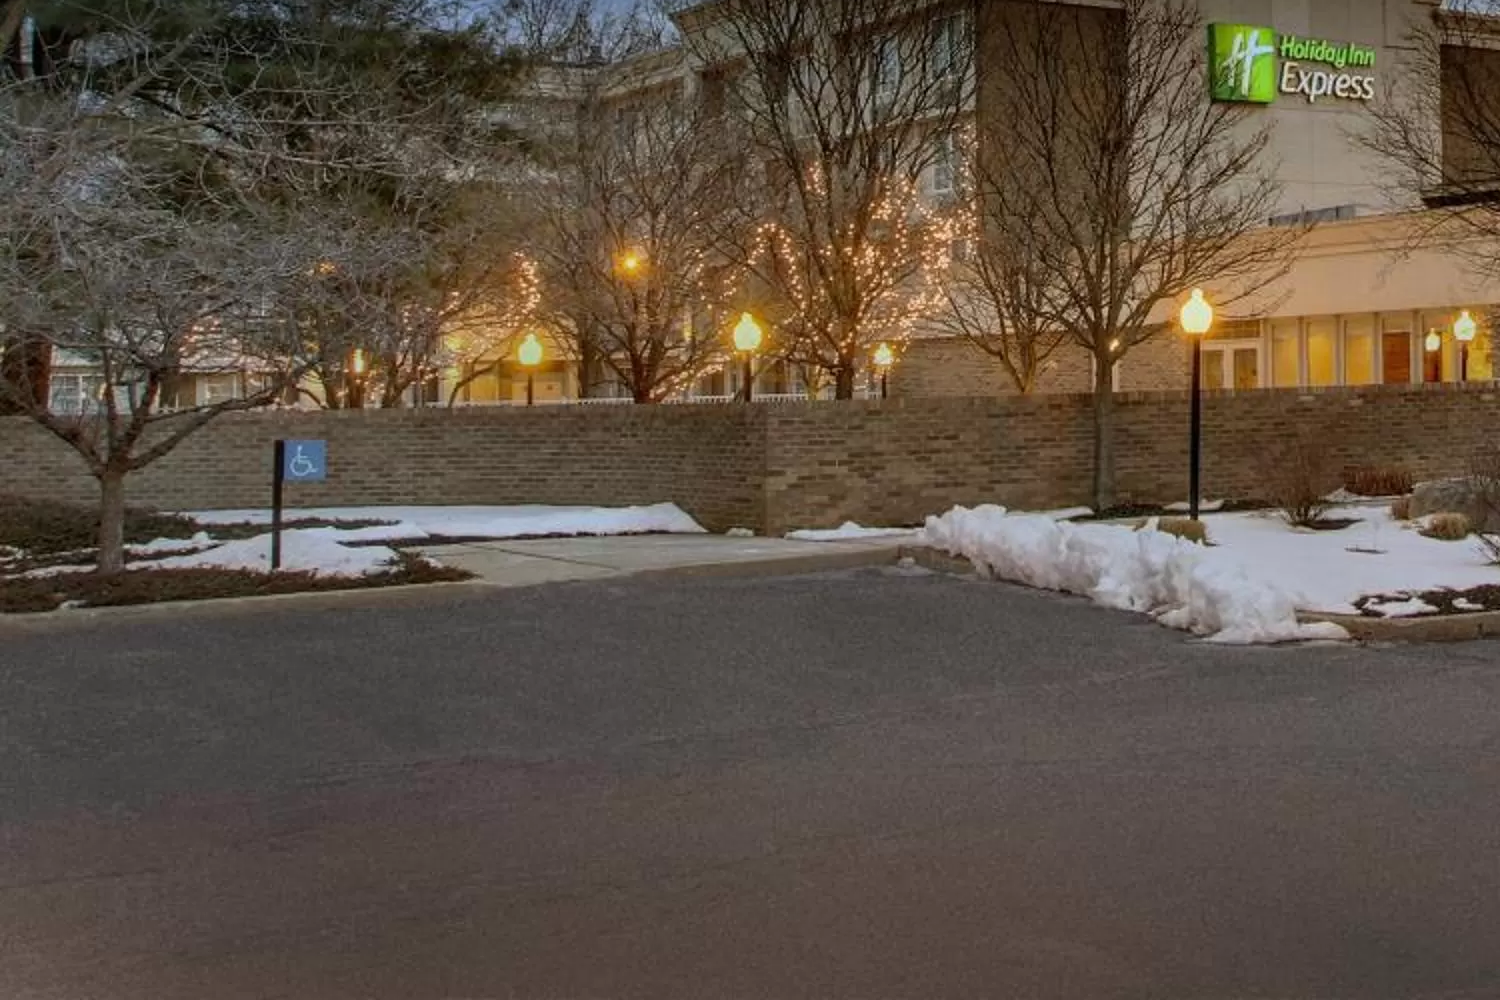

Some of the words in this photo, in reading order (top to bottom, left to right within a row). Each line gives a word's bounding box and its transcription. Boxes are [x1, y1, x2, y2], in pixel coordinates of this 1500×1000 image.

[1280, 34, 1347, 68] Holiday
[1348, 42, 1376, 66] Inn
[1281, 61, 1375, 103] Express
